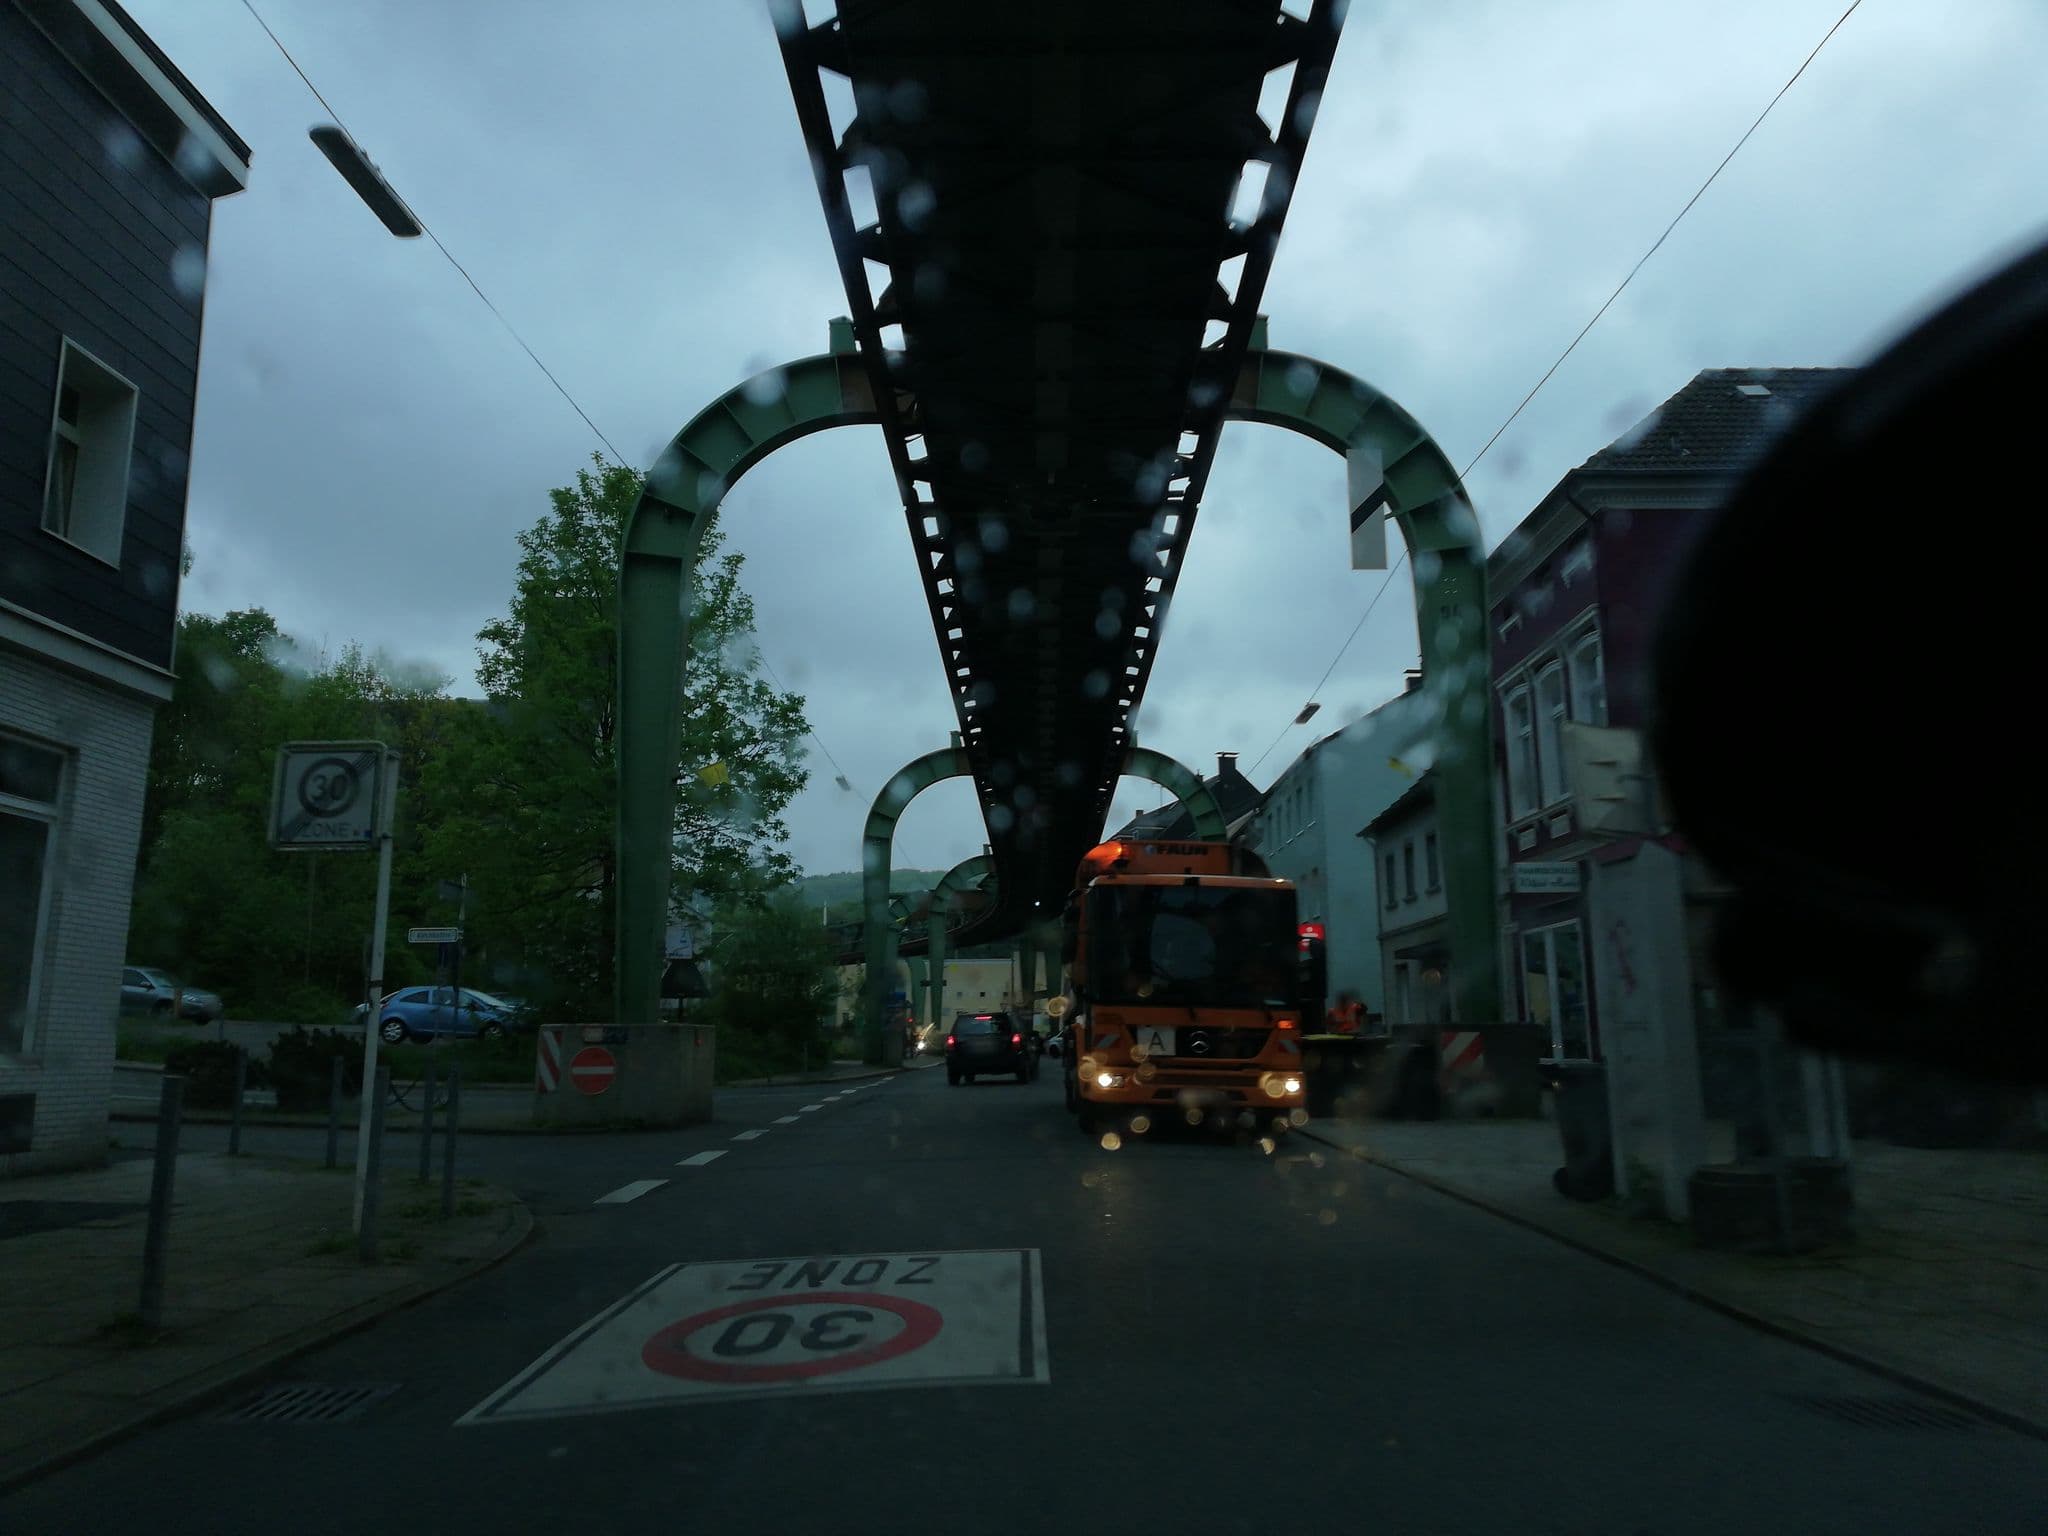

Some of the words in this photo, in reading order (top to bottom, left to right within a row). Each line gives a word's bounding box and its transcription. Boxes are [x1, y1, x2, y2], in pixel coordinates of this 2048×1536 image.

[311, 774, 347, 801] 30
[300, 822, 350, 839] ZONE
[1147, 1031, 1166, 1052] A
[726, 1257, 941, 1291] ZONE
[712, 1310, 874, 1357] 30
